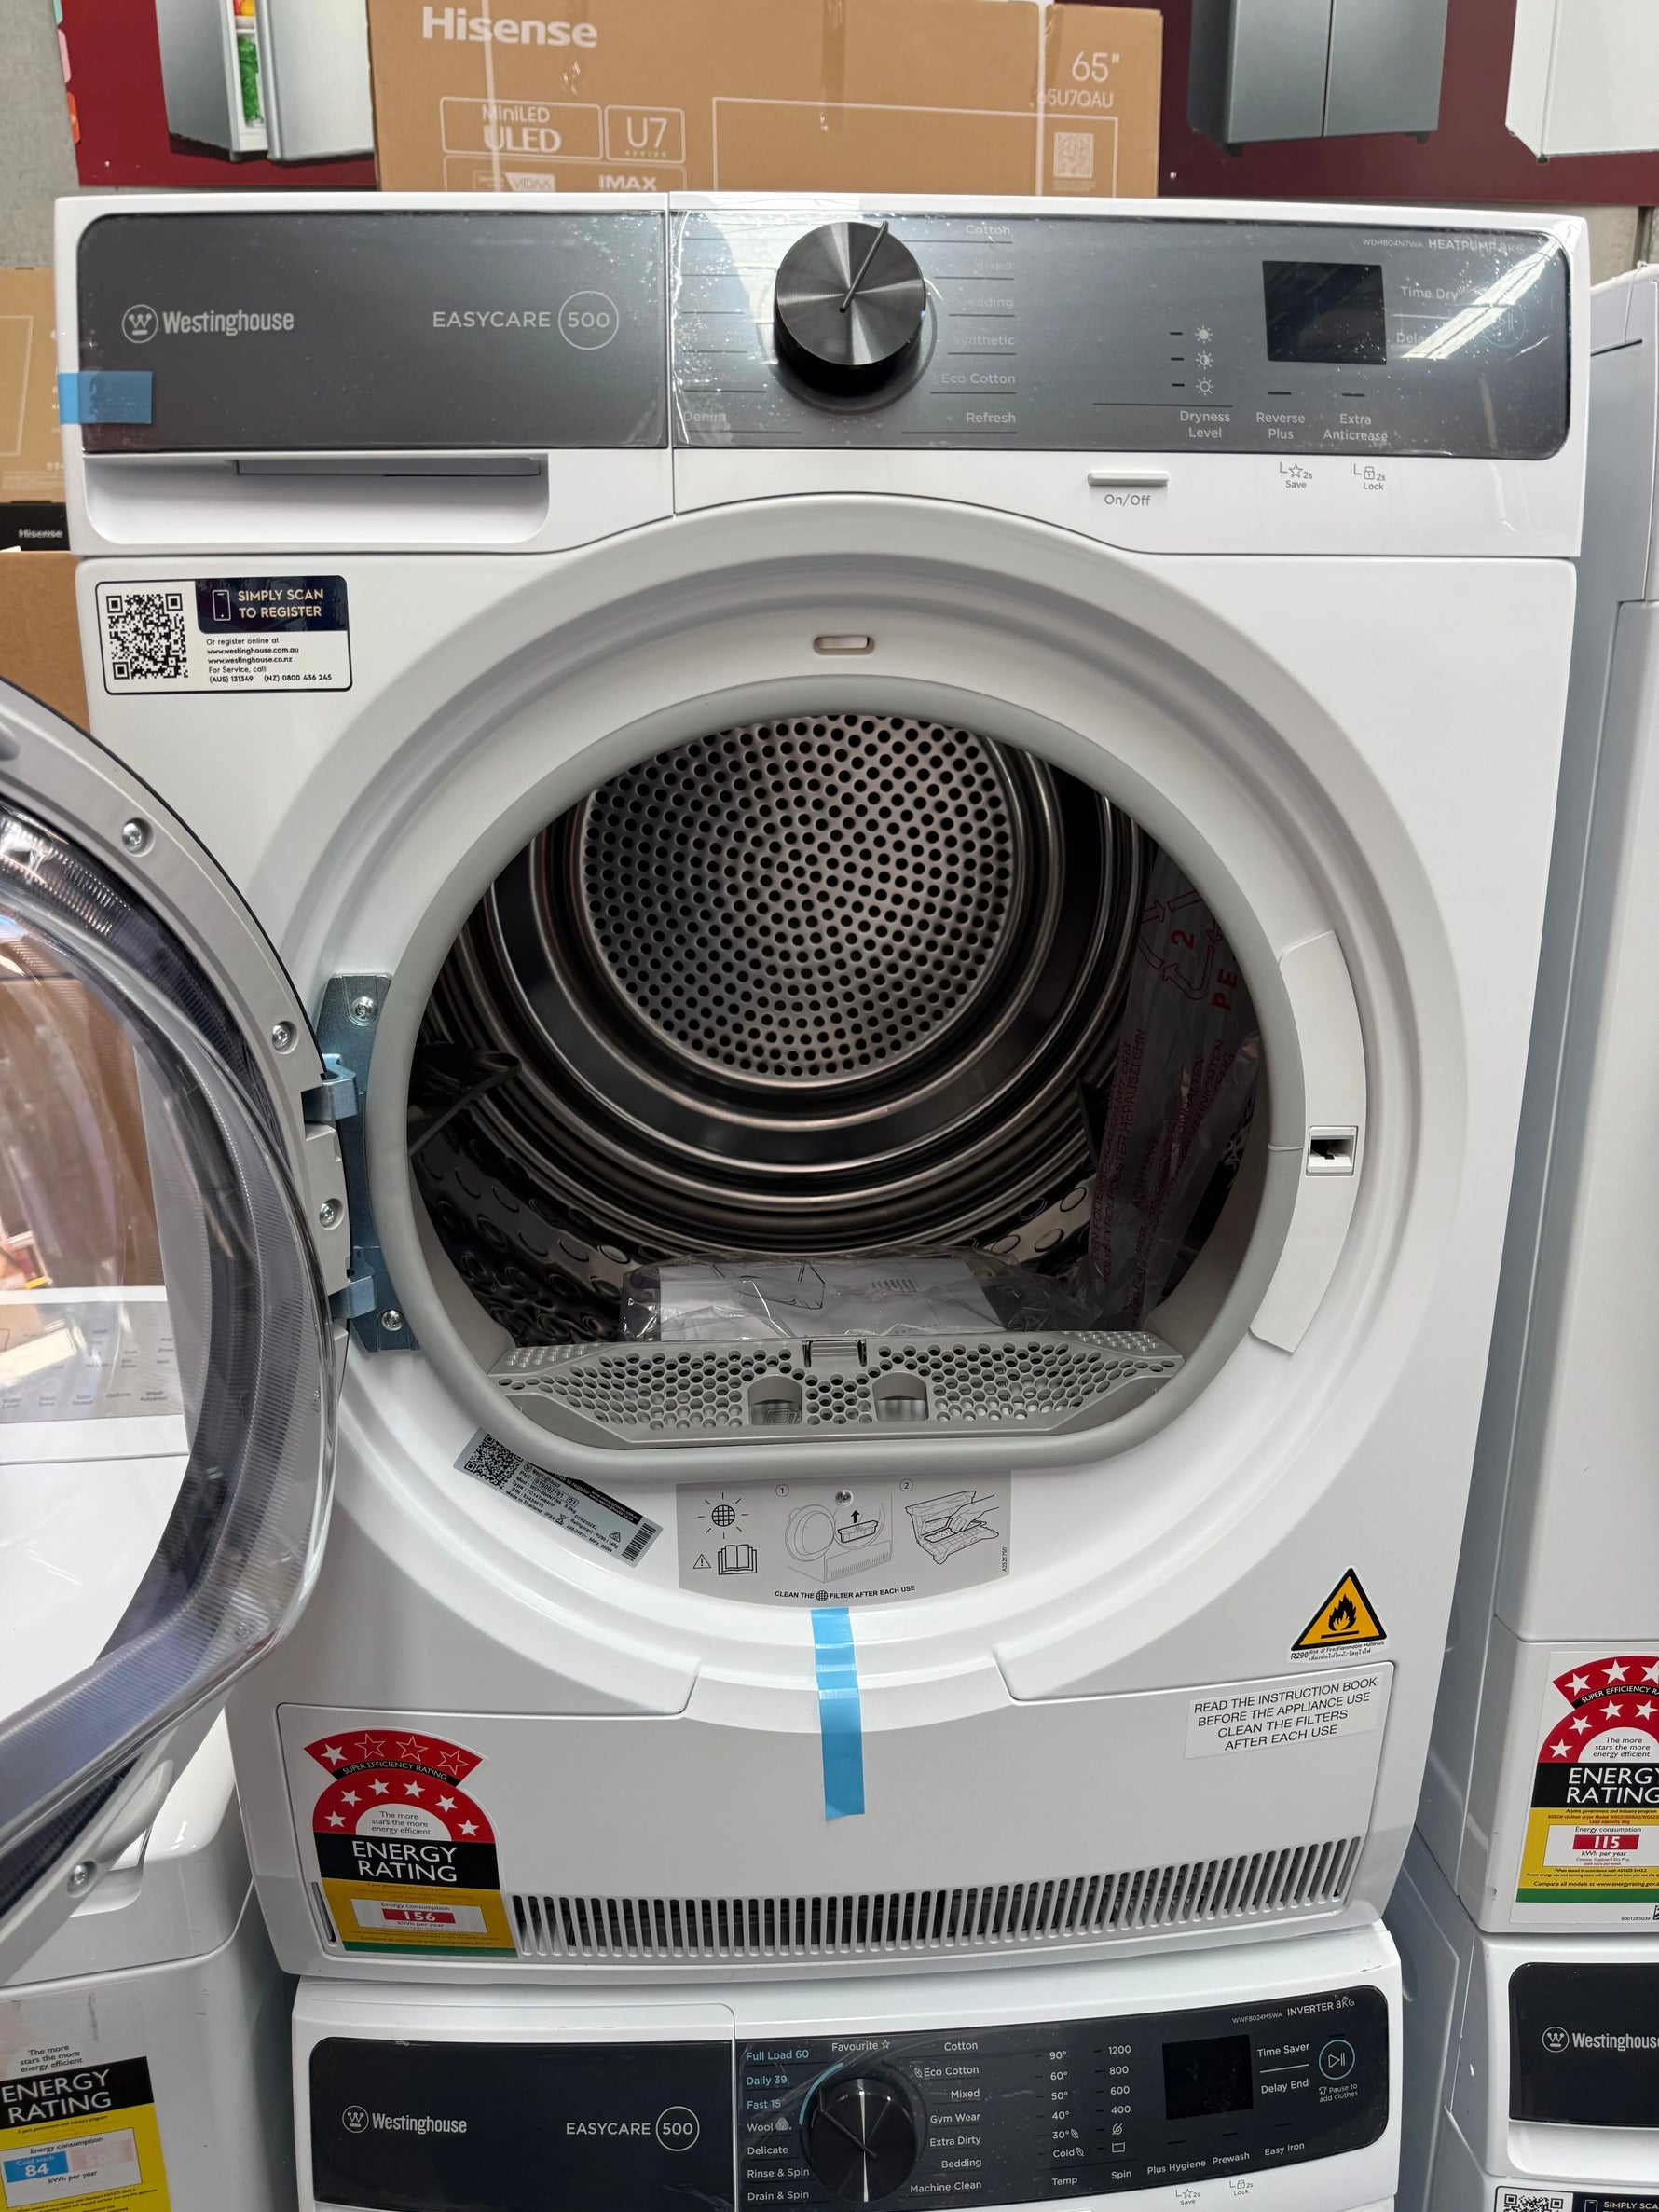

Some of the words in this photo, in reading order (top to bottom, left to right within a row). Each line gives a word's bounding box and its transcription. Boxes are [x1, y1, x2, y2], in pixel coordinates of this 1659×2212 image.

[422, 6, 597, 48] Hisense
[483, 104, 550, 123] MiniLED
[626, 116, 667, 148] U7
[484, 124, 561, 153] ULED
[599, 174, 656, 191] IMAX
[966, 226, 1010, 235] Cotton
[1429, 240, 1495, 251] HEATPUMP
[1401, 286, 1432, 298] Time
[1436, 288, 1459, 301] Dry
[162, 309, 295, 337] Westinghouse
[432, 311, 551, 328] EASYCARE
[568, 312, 610, 328] 500
[953, 336, 1015, 346] Synthetic
[941, 374, 966, 384] Eco
[970, 374, 1015, 384] Cotton
[683, 411, 726, 421] Denim
[966, 413, 1016, 423] Refresh
[1180, 411, 1230, 424] Dryness
[1255, 412, 1305, 424] Reverse
[1339, 413, 1372, 425] Extra
[1188, 427, 1222, 439] Level
[1268, 429, 1294, 440] Plus
[1323, 430, 1388, 443] Anticrease
[1363, 482, 1384, 490] Lock
[1104, 493, 1150, 506] On/Off
[19, 529, 63, 538] Hisense
[238, 590, 282, 602] SIMPLY
[286, 589, 323, 600] SCAN
[240, 608, 256, 618] TO
[261, 606, 322, 618] REGISTER
[207, 647, 299, 655] www.westinghouse.com.au
[210, 675, 228, 683] (AUS)
[264, 674, 280, 682] (NZ)
[856, 1590, 878, 1599] AFTER
[1194, 1701, 1227, 1713] READ
[1231, 1697, 1255, 1708] THE
[1259, 1684, 1338, 1705] INSTRUCTION
[1343, 1678, 1378, 1690] BOOK
[1582, 1690, 1605, 1703] SUPER
[1606, 1685, 1651, 1696] EFFICIENCY
[1199, 1710, 1246, 1726] BEFORE
[1251, 1706, 1274, 1717] THE
[1277, 1698, 1343, 1715] APPLIANCE
[1347, 1692, 1370, 1704] USE
[1218, 1724, 1262, 1738] CLEAN
[1267, 1720, 1292, 1730] THE
[1296, 1710, 1348, 1725] FILTERS
[1225, 1737, 1268, 1751] AFTER
[1271, 1731, 1308, 1743] EACH
[1311, 1724, 1337, 1737] USE
[343, 1763, 366, 1773] SUPER
[367, 1761, 413, 1769] EFFICIENCY
[417, 1765, 447, 1780] RATING
[1595, 1836, 1620, 1848] 115
[352, 1841, 457, 1863] ENERGY
[358, 1861, 457, 1881] RATING
[405, 1912, 435, 1921] 156
[1287, 2002, 1334, 2016] INVERTER
[1336, 1999, 1355, 2009] 8KG
[832, 2041, 878, 2052] Favourite
[944, 2041, 978, 2051] Cotton
[1108, 2045, 1131, 2054] 1200
[1257, 2046, 1282, 2058] Time
[1284, 2043, 1309, 2054] Saver
[747, 2051, 764, 2061] Full
[768, 2050, 792, 2060] Load
[795, 2050, 809, 2058] 60
[924, 2068, 943, 2076] Eco
[946, 2066, 979, 2075] Cotton
[1109, 2066, 1129, 2074] 800
[2, 2069, 109, 2103] ENERGY
[747, 2077, 772, 2086] Daily
[775, 2075, 787, 2084] 39
[1110, 2086, 1130, 2095] 600
[1260, 2081, 1287, 2095] Delay
[1290, 2080, 1309, 2089] End
[951, 2089, 980, 2098] Mixed
[1334, 2091, 1358, 2100] clothes
[8, 2092, 111, 2123] RATING
[747, 2100, 768, 2109] Fast
[771, 2099, 780, 2108] 15
[1111, 2105, 1131, 2114] 400
[372, 2112, 467, 2135] Westinghouse
[930, 2114, 952, 2124] Gym
[954, 2113, 980, 2123] Wear
[566, 2122, 651, 2135] EASYCARE
[662, 2123, 693, 2135] 500
[747, 2123, 774, 2132] Wool
[930, 2137, 954, 2147] Extra
[957, 2136, 981, 2146] Dirty
[747, 2146, 788, 2155] Delicate
[1053, 2149, 1075, 2157] Cold
[1264, 2145, 1284, 2156] Easy
[1287, 2142, 1305, 2151] Iron
[1213, 2151, 1250, 2164] Prewash
[941, 2159, 981, 2168] Bedding
[1147, 2165, 1167, 2174] Plus
[1169, 2159, 1206, 2172] Hygiene
[25, 2163, 48, 2177] 84
[747, 2169, 775, 2178] Rinse
[788, 2168, 809, 2178] Spin
[1111, 2170, 1131, 2180] Spin
[911, 2183, 951, 2192] Machine
[953, 2181, 981, 2190] Clean
[1052, 2176, 1077, 2187] Temp
[747, 2191, 775, 2201] Drain
[788, 2191, 809, 2201] Spin
